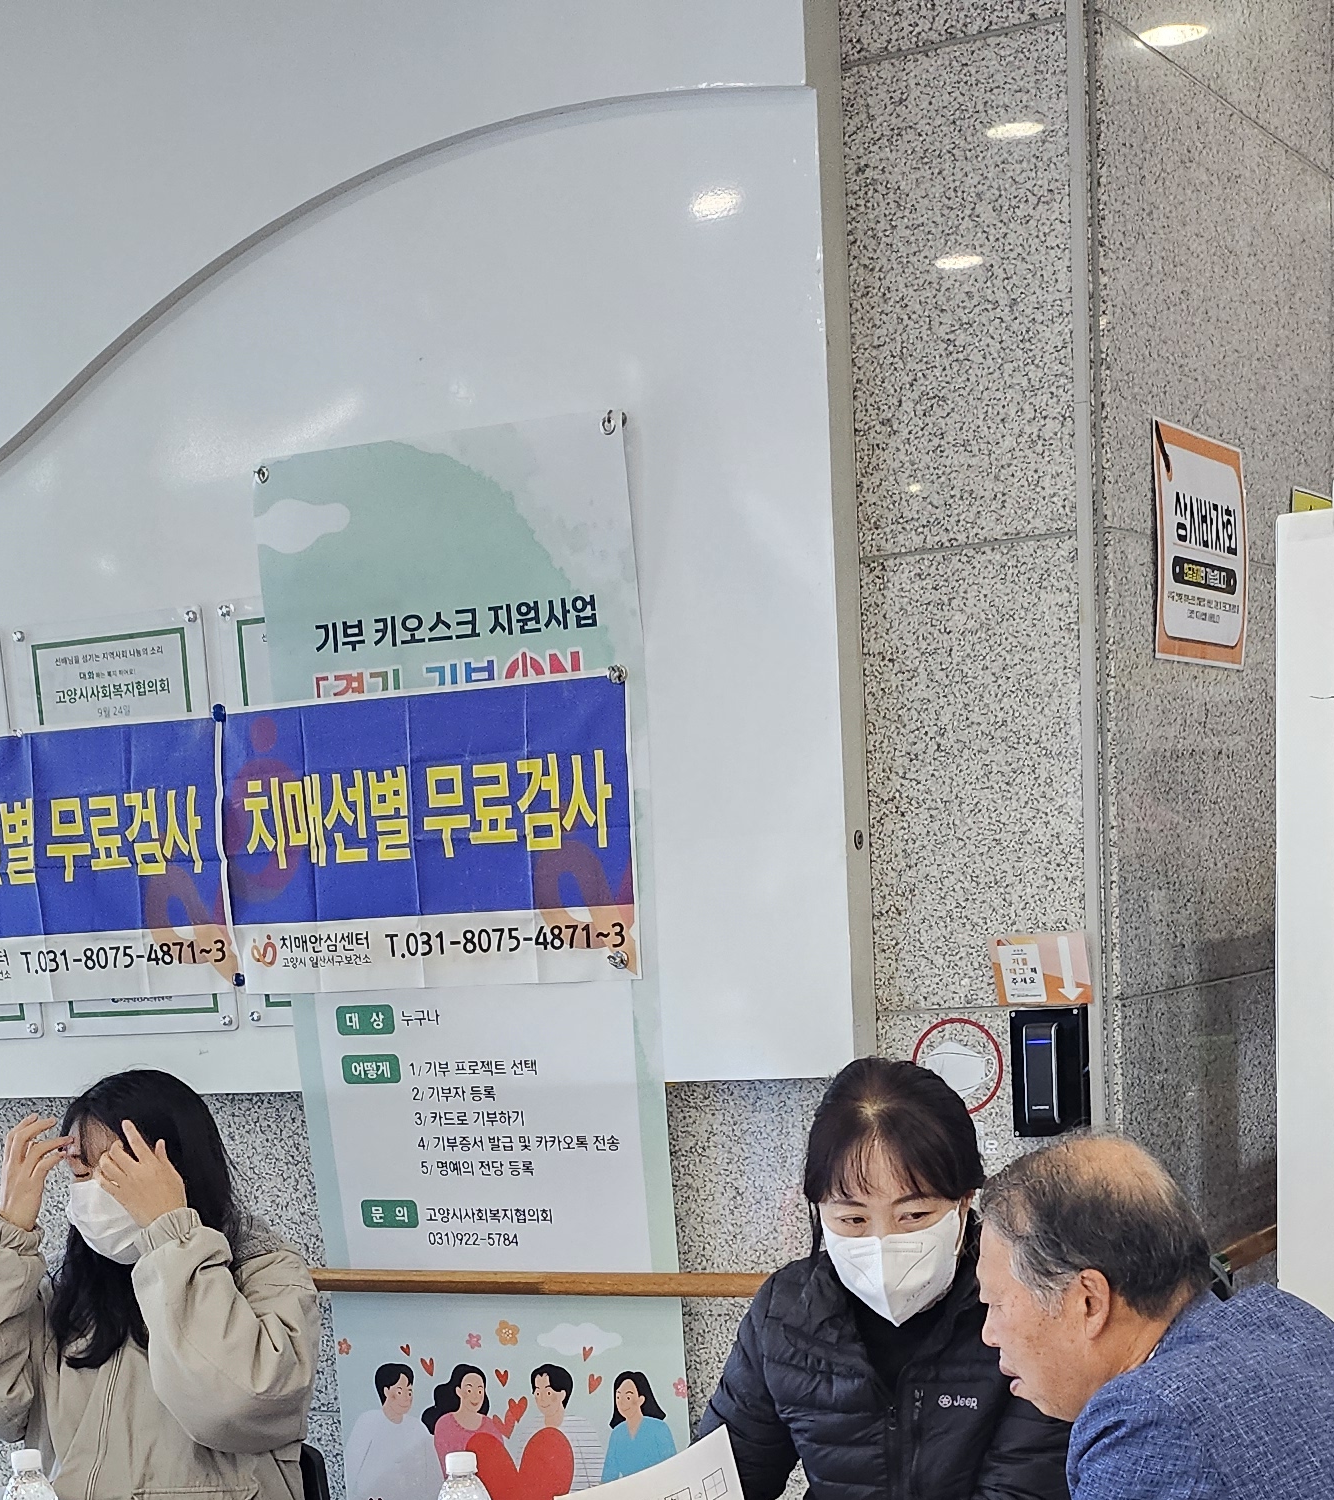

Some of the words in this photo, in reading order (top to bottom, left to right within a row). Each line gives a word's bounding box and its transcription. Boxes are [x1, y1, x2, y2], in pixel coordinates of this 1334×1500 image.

[1175, 491, 1238, 557] 상시바자회
[315, 618, 365, 654] 기부
[373, 607, 481, 648] 키오스크
[488, 593, 598, 636] 지원사업
[82, 653, 100, 664] 섬기는
[102, 650, 128, 661] 지역사회
[129, 647, 148, 657] 나눔의
[150, 645, 164, 655] 소리
[55, 677, 171, 704] 고양시사회복지협의회
[97, 706, 110, 718] 9월
[113, 704, 131, 717] 24일
[244, 765, 412, 869] 치매선별
[423, 749, 613, 859] 무료검사
[46, 785, 204, 882] 무료검사
[279, 931, 371, 954] 치매안심센터
[384, 921, 626, 959] T.031-8075-4871~3
[20, 938, 227, 976] T.031-8075-4871~3
[281, 955, 307, 969] 고양시
[308, 952, 372, 968] 일산서구보건소
[401, 1009, 440, 1026] 누구나
[351, 1062, 391, 1080] 어떻게
[424, 1061, 451, 1077] 기부
[454, 1059, 506, 1076] 프로젝트
[510, 1059, 538, 1076] 선택
[428, 1086, 466, 1102] 기부자
[470, 1086, 496, 1102] 등록
[430, 1111, 469, 1127] 카드로
[473, 1110, 525, 1127] 기부하기
[433, 1136, 484, 1152] 기부증서
[488, 1136, 514, 1151] 발급
[518, 1136, 532, 1151] 및
[535, 1136, 589, 1151] 카카오톡
[592, 1135, 620, 1151] 전송
[436, 1160, 475, 1177] 명예의
[478, 1160, 504, 1176] 전당
[508, 1160, 535, 1177] 등록
[425, 1206, 553, 1225] 고양시사회복지협의회
[427, 1230, 520, 1248] 031)922-5784
[953, 1394, 978, 1410] Jeep
